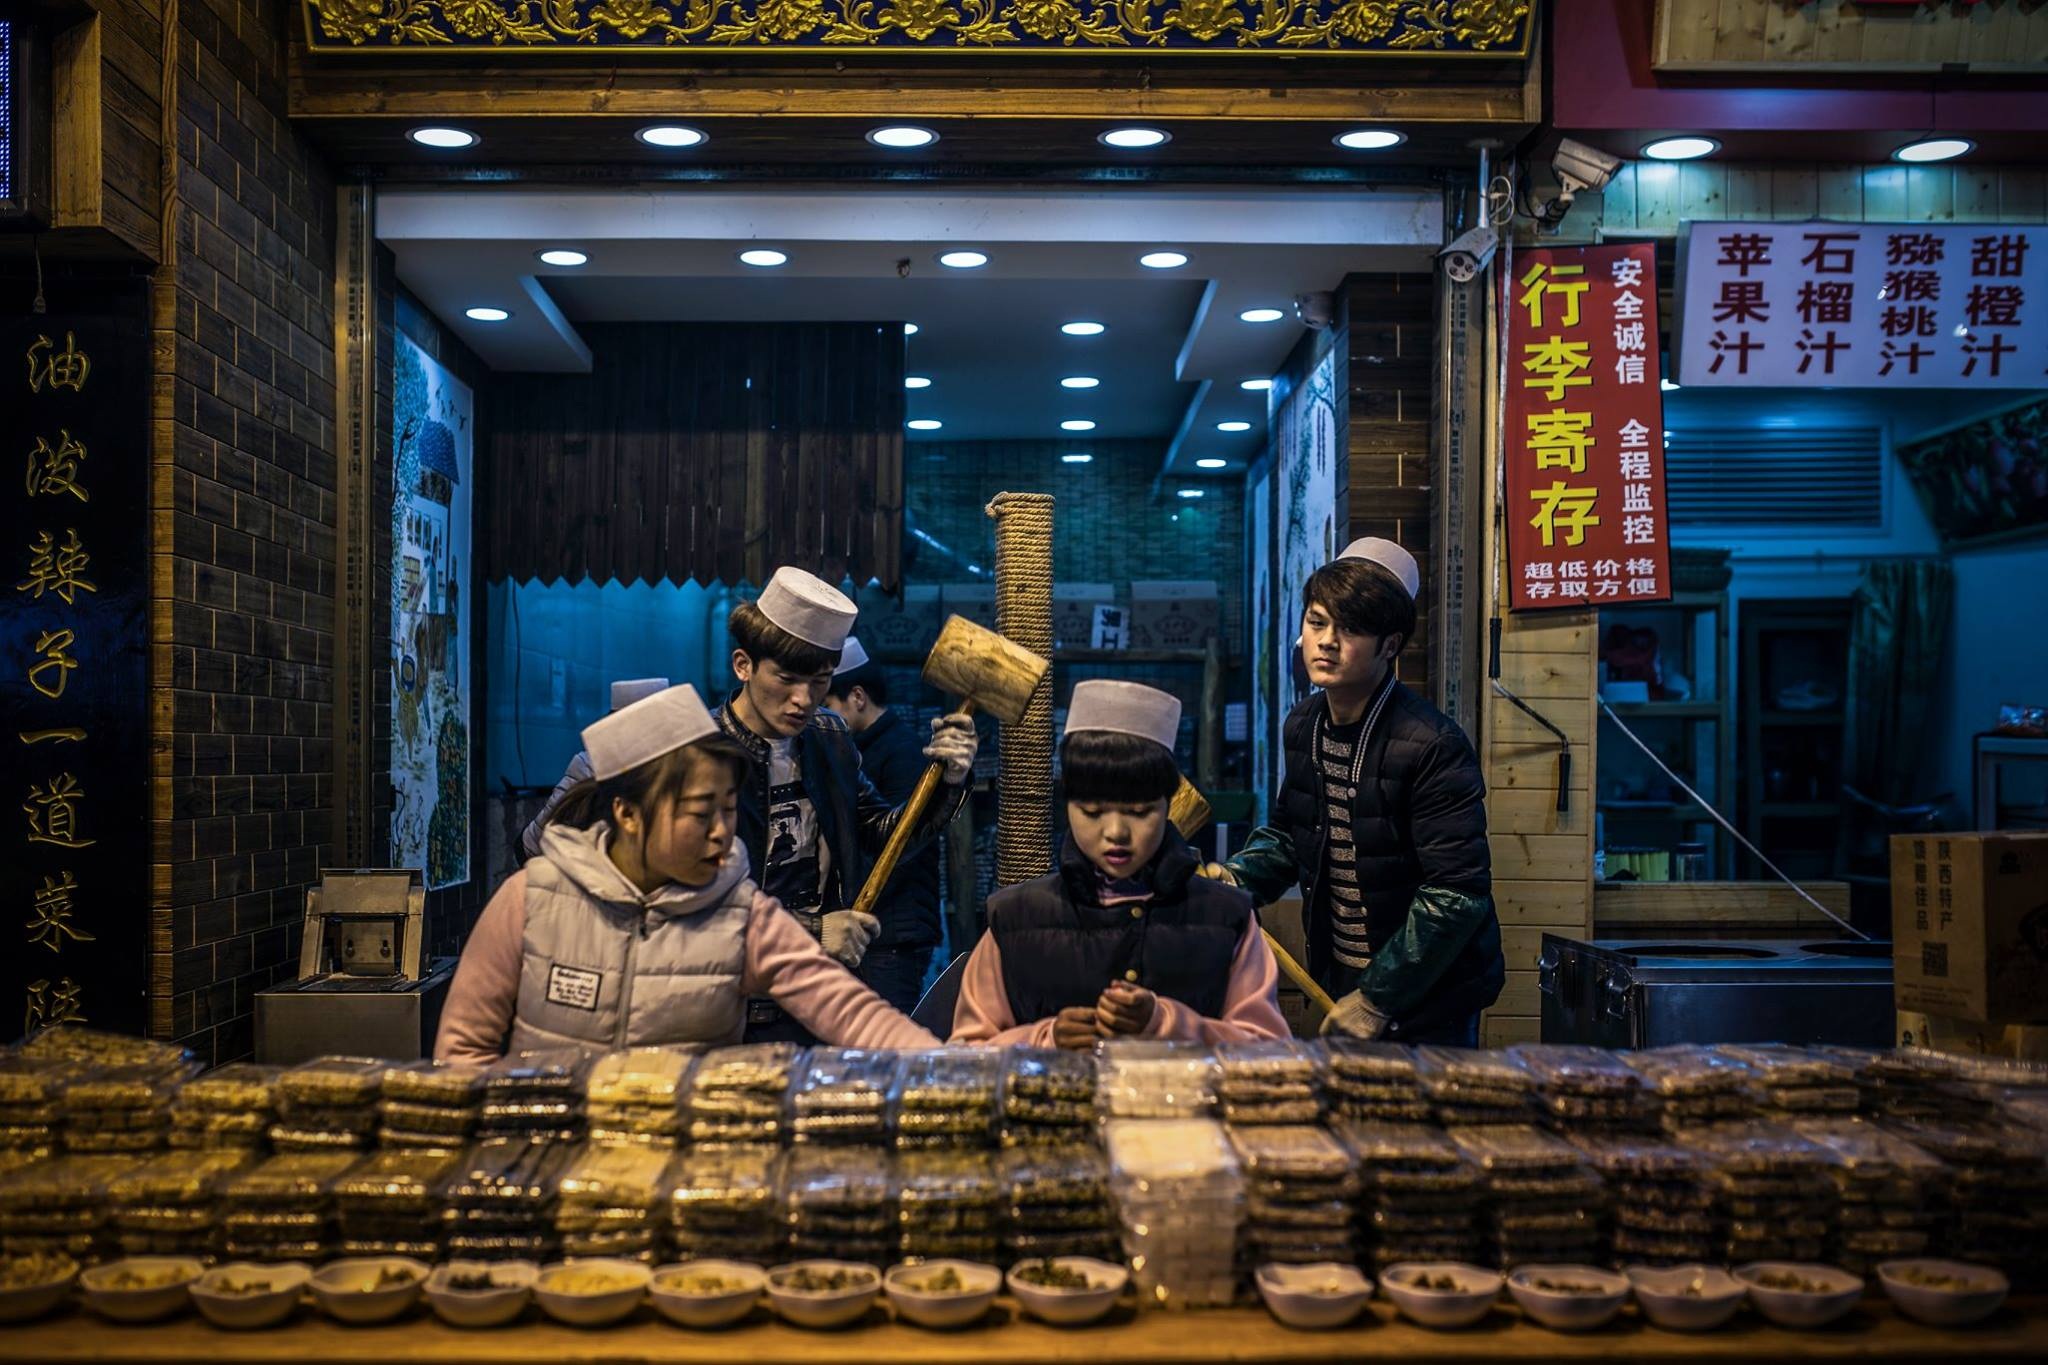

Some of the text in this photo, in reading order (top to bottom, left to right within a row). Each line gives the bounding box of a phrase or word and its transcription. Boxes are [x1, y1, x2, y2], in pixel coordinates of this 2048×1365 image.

[1708, 233, 1774, 375] 苹果汁
[1795, 232, 1861, 375] 石榴汁
[1878, 233, 1946, 377] 猕猴桃汁
[1961, 234, 2031, 377] 甜橙汁
[1519, 262, 1601, 548] 行李寄存
[1611, 257, 1656, 545] 安全诚信 全程监控
[1524, 557, 1656, 579] 超低价格
[1525, 577, 1657, 599] 存取方便
